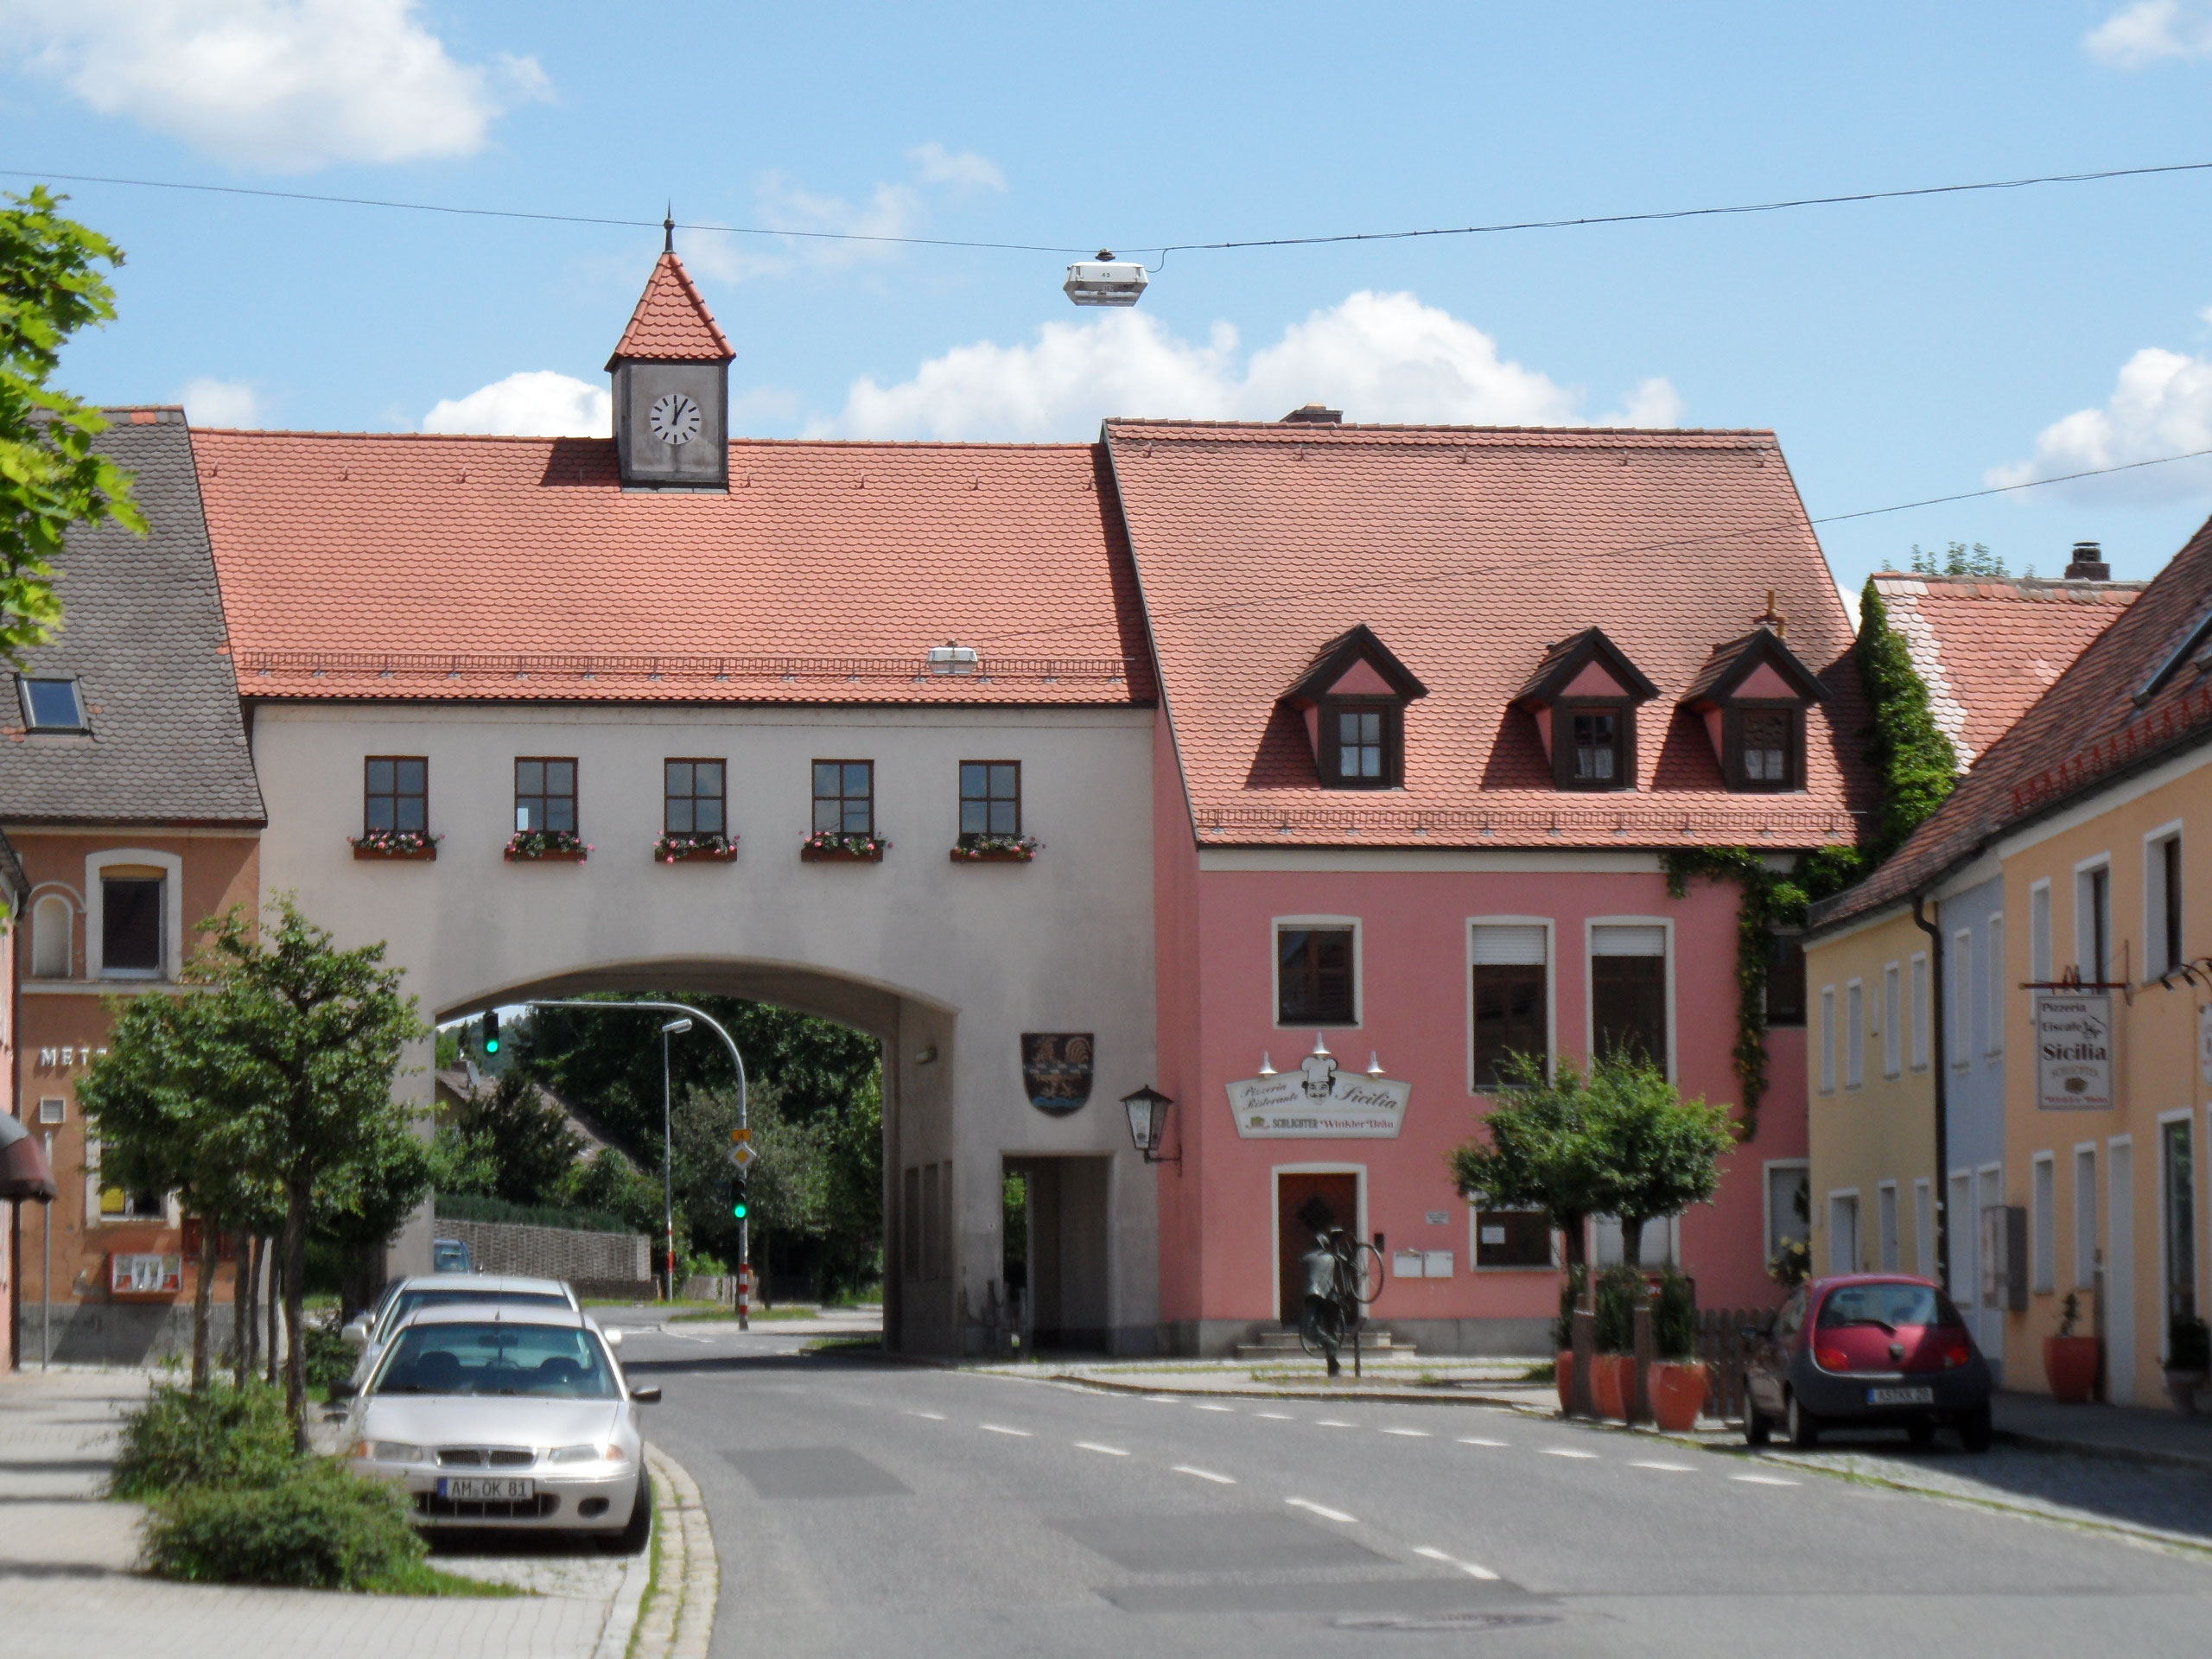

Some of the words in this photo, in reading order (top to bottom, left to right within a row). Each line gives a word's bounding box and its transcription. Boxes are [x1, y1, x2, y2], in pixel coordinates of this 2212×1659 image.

[2043, 1003, 2087, 1013] Pizzeria
[41, 1047, 107, 1067] MET
[2043, 1043, 2107, 1061] Sicilia
[1334, 1084, 1399, 1109] Sicilia
[452, 1481, 472, 1497] AM
[482, 1481, 502, 1497] OK
[508, 1481, 526, 1497] 81
